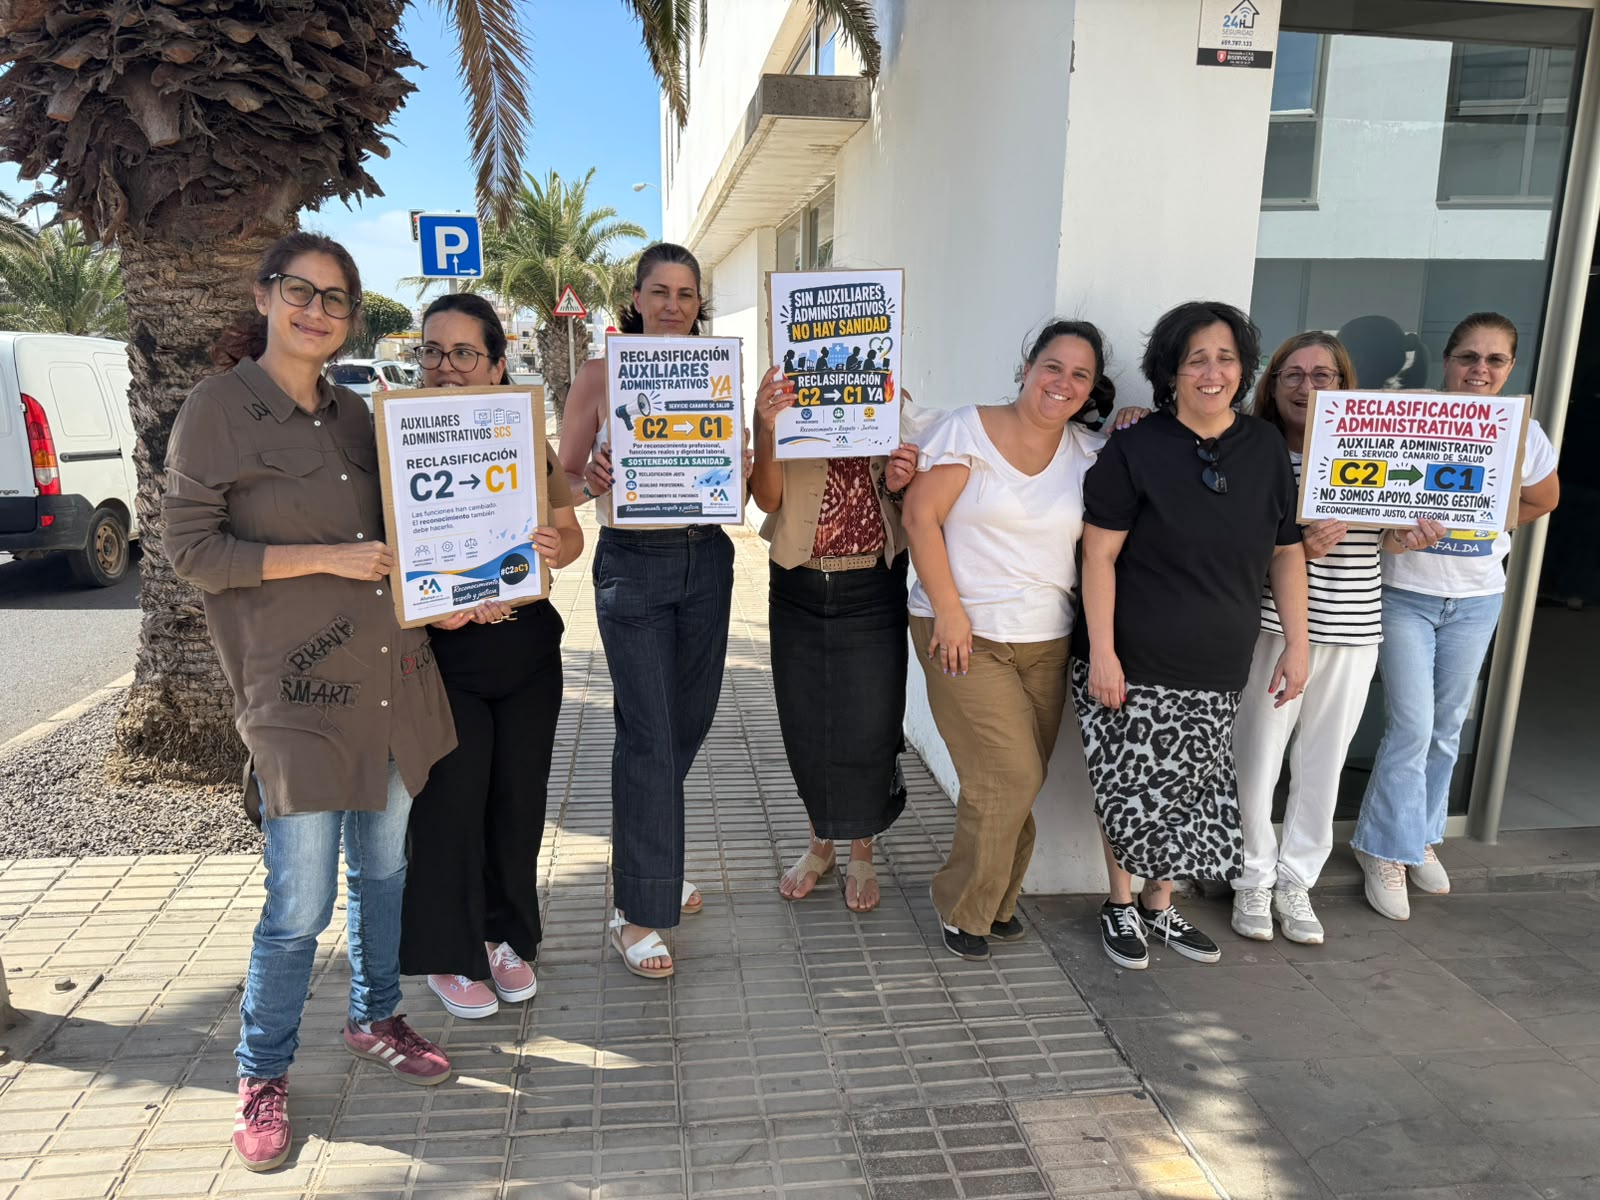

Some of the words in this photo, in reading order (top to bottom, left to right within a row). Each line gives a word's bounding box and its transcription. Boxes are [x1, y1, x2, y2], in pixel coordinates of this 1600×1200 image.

[434, 226, 469, 269] P
[794, 291, 814, 307] SIN
[817, 284, 882, 304] AUXILIARES
[794, 300, 884, 322] ADMINISTRATIVOS
[792, 323, 810, 340] NO
[814, 320, 836, 338] HAY
[839, 316, 888, 335] SANIDAD
[620, 346, 729, 362] RECLASIFICACIÓN
[618, 363, 709, 378] AUXILIARES
[798, 372, 881, 387] RECLASIFICACIÓN
[620, 378, 708, 390] ADMINISTRATIVOS
[710, 374, 732, 396] YA
[798, 387, 820, 406] C2
[844, 386, 862, 403] C1
[867, 387, 883, 401] YA
[1345, 399, 1491, 420] RECLASIFICACIÓN
[401, 414, 460, 430] AUXILIARES
[642, 418, 668, 439] C2
[700, 416, 722, 438] C1
[1336, 417, 1474, 437] ADMINISTRATIVA
[1479, 423, 1498, 439] YA
[402, 428, 492, 446] ADMINISTRATIVOS
[493, 426, 511, 438] SCS
[1337, 438, 1394, 449] AUXILIAR
[1400, 440, 1493, 455] ADMINISTRATIVO
[1362, 450, 1398, 459] SERVICIO
[1403, 452, 1440, 461] CANARIO
[1458, 454, 1484, 463] SALUD
[406, 448, 517, 469] RECLASIFICACIÓN
[410, 470, 454, 502] C2
[485, 463, 518, 493] C1
[1339, 462, 1379, 485] C2
[1434, 466, 1474, 490] C1
[1320, 488, 1336, 500] NO
[1340, 489, 1374, 502] SOMOS
[1378, 490, 1412, 504] APOYO,
[1415, 494, 1449, 507] SOMOS
[1452, 494, 1490, 508] GESTIÓN
[420, 515, 470, 525] reconocimiento
[424, 507, 454, 516] funciones
[1316, 505, 1380, 516] RECONOCIMIENTO
[1383, 508, 1406, 519] JUSTO,
[1409, 510, 1450, 521] CATEGORÍA
[1454, 514, 1474, 523] JUSTA
[500, 563, 529, 576] #C2aC1
[282, 680, 353, 704] SMART
